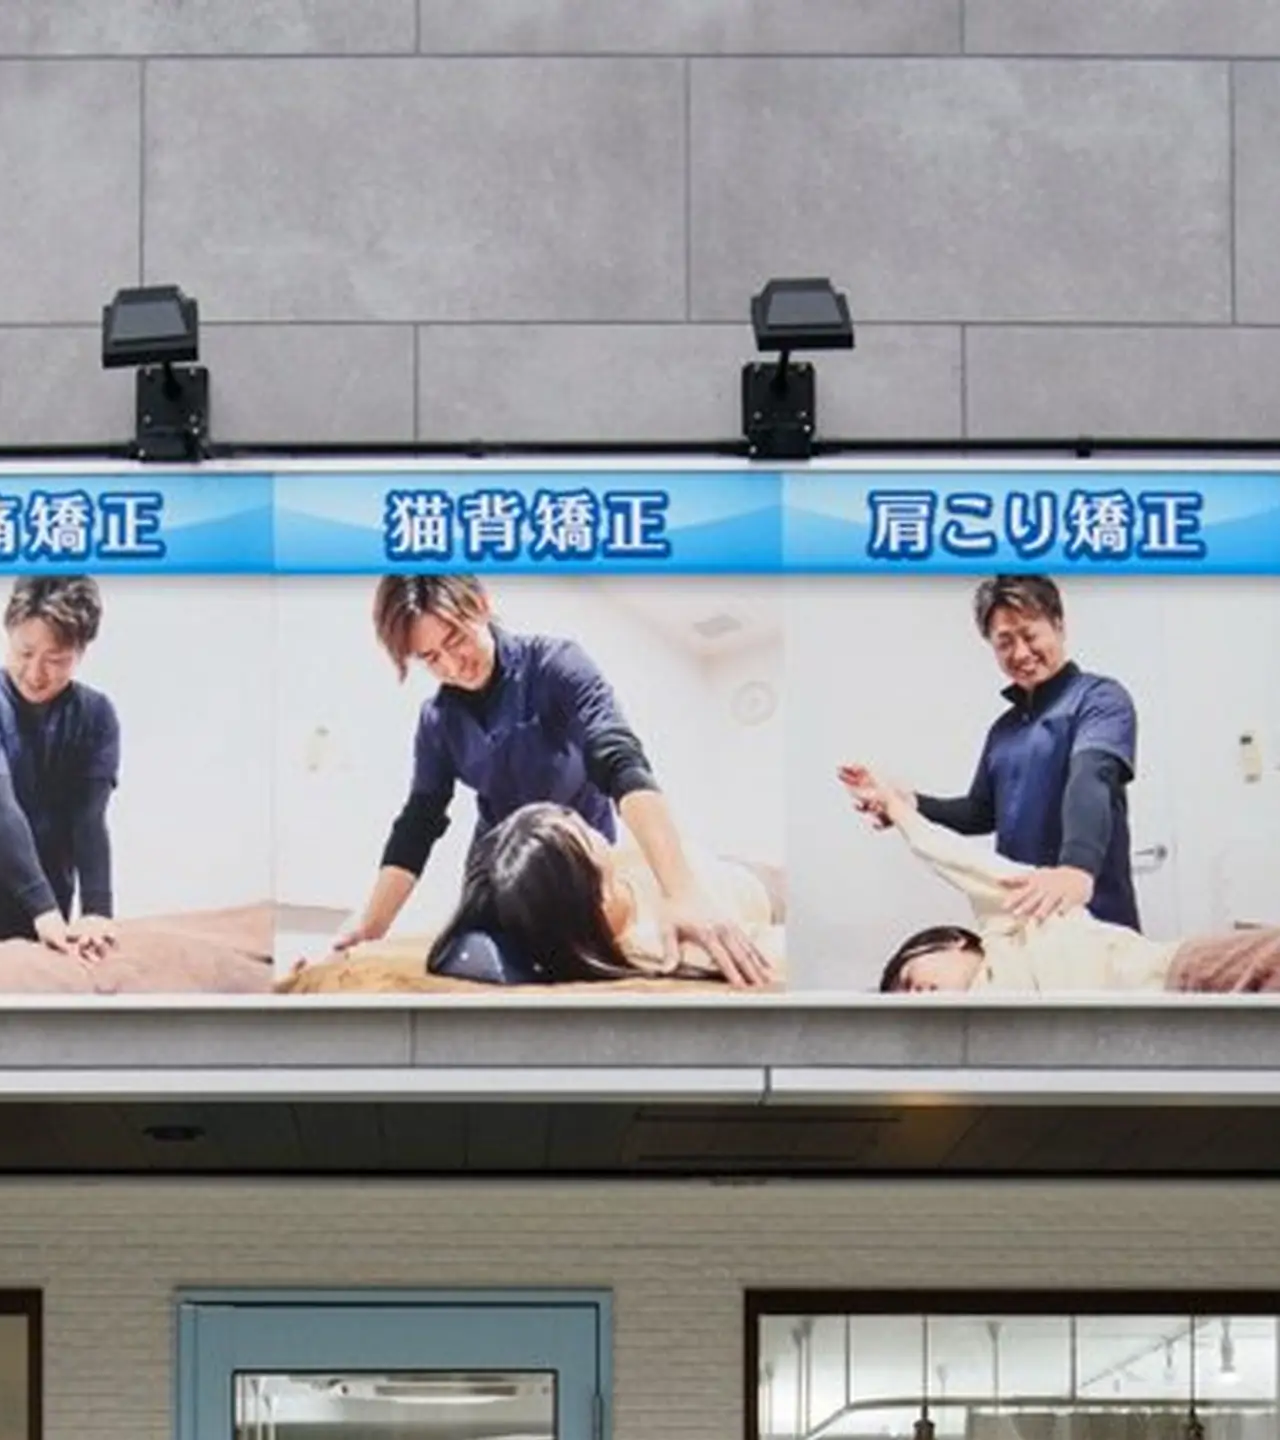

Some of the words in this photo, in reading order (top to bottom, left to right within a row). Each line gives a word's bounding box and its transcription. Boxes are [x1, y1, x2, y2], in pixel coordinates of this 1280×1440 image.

[387, 491, 669, 559] 猫背矯正
[869, 491, 1202, 558] 肩こり矯正
